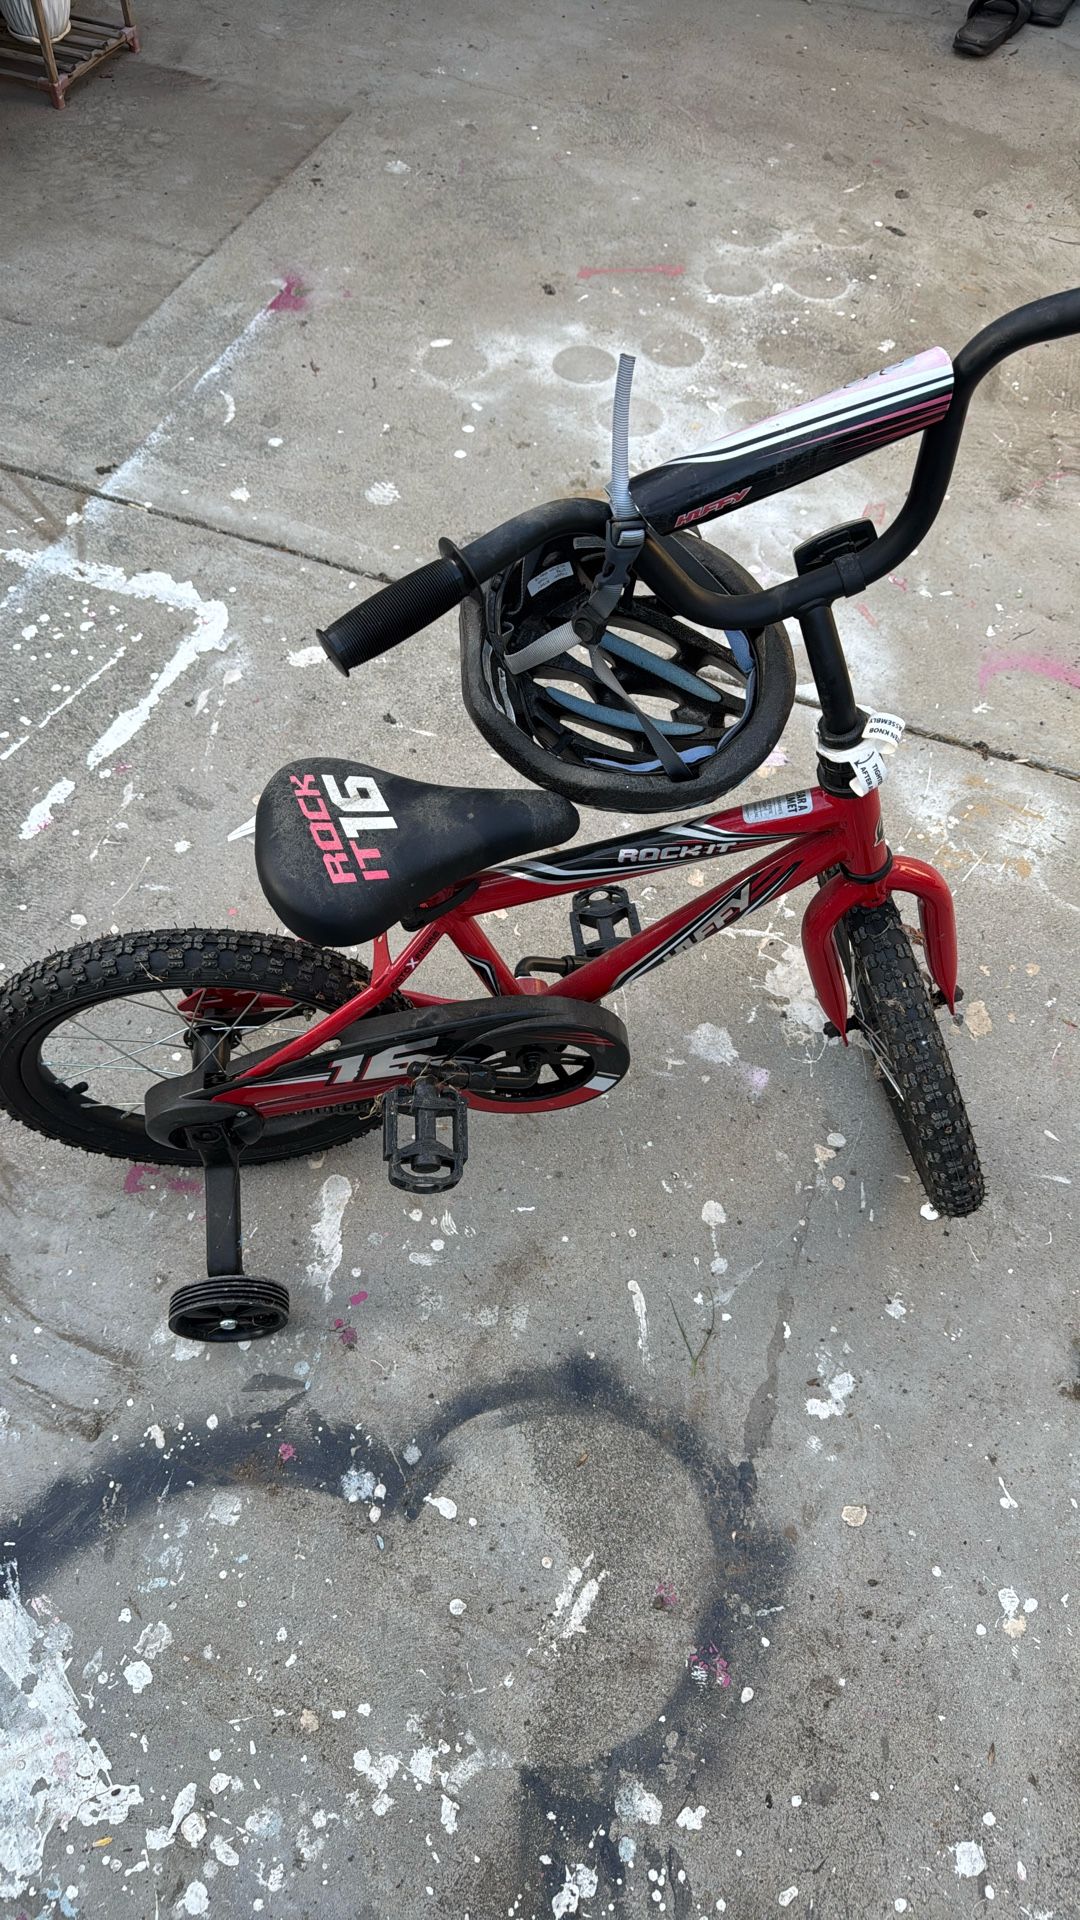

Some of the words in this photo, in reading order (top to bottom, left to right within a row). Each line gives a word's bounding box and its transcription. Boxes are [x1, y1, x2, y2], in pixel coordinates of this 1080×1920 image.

[674, 486, 752, 528] HUFFY
[869, 717, 902, 731] ASSEMBLY
[869, 727, 890, 736] KNOB
[860, 766, 873, 786] AFTER
[321, 773, 398, 838] 16
[289, 774, 358, 884] ROCK
[349, 839, 390, 881] IT
[617, 845, 703, 863] ROCK
